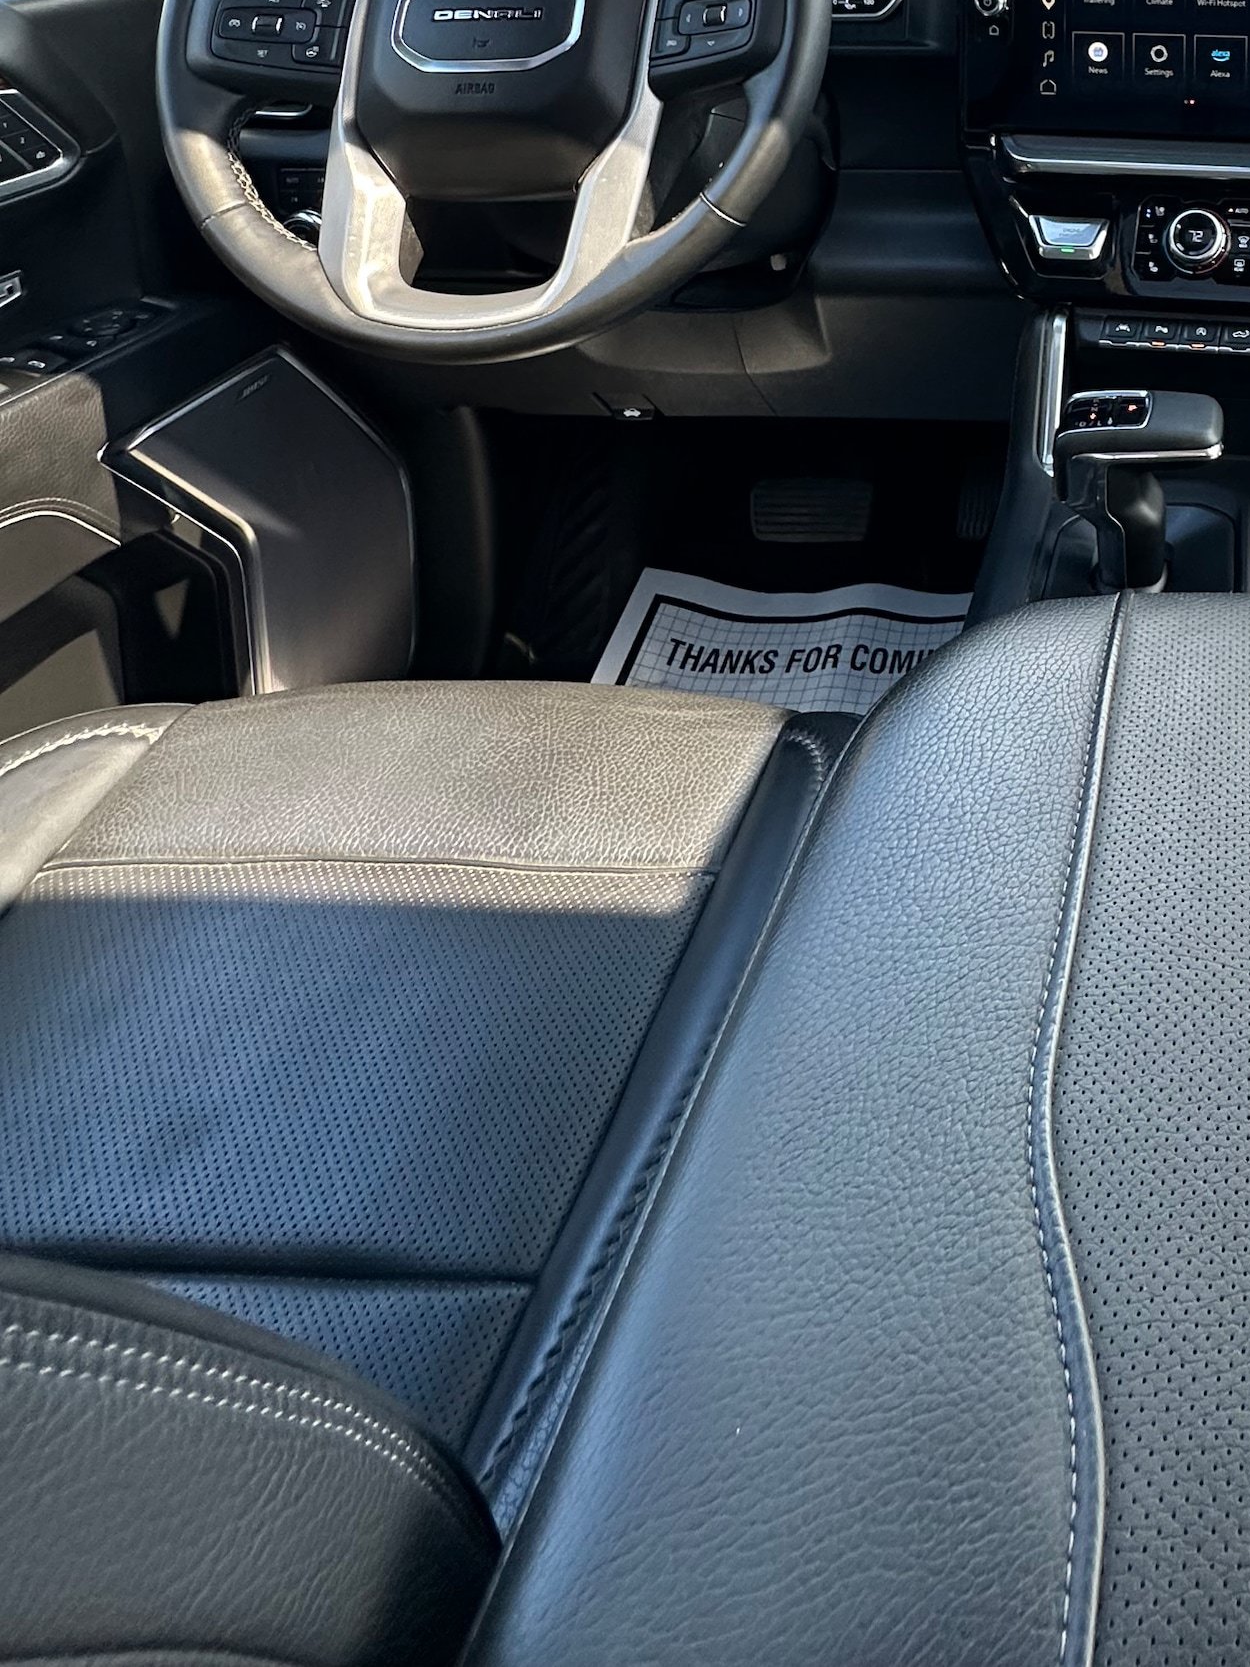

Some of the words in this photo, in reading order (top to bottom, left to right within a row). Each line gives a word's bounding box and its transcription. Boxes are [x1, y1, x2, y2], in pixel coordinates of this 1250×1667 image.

[433, 10, 542, 21] DENALI
[1088, 66, 1108, 75] News
[1145, 67, 1174, 78] Settings
[1210, 70, 1231, 78] Alexa
[455, 82, 495, 95] AIRBAG
[1188, 230, 1204, 243] 72
[666, 638, 779, 675] THANKS
[785, 644, 842, 674] FOR
[850, 644, 935, 675] COMI
